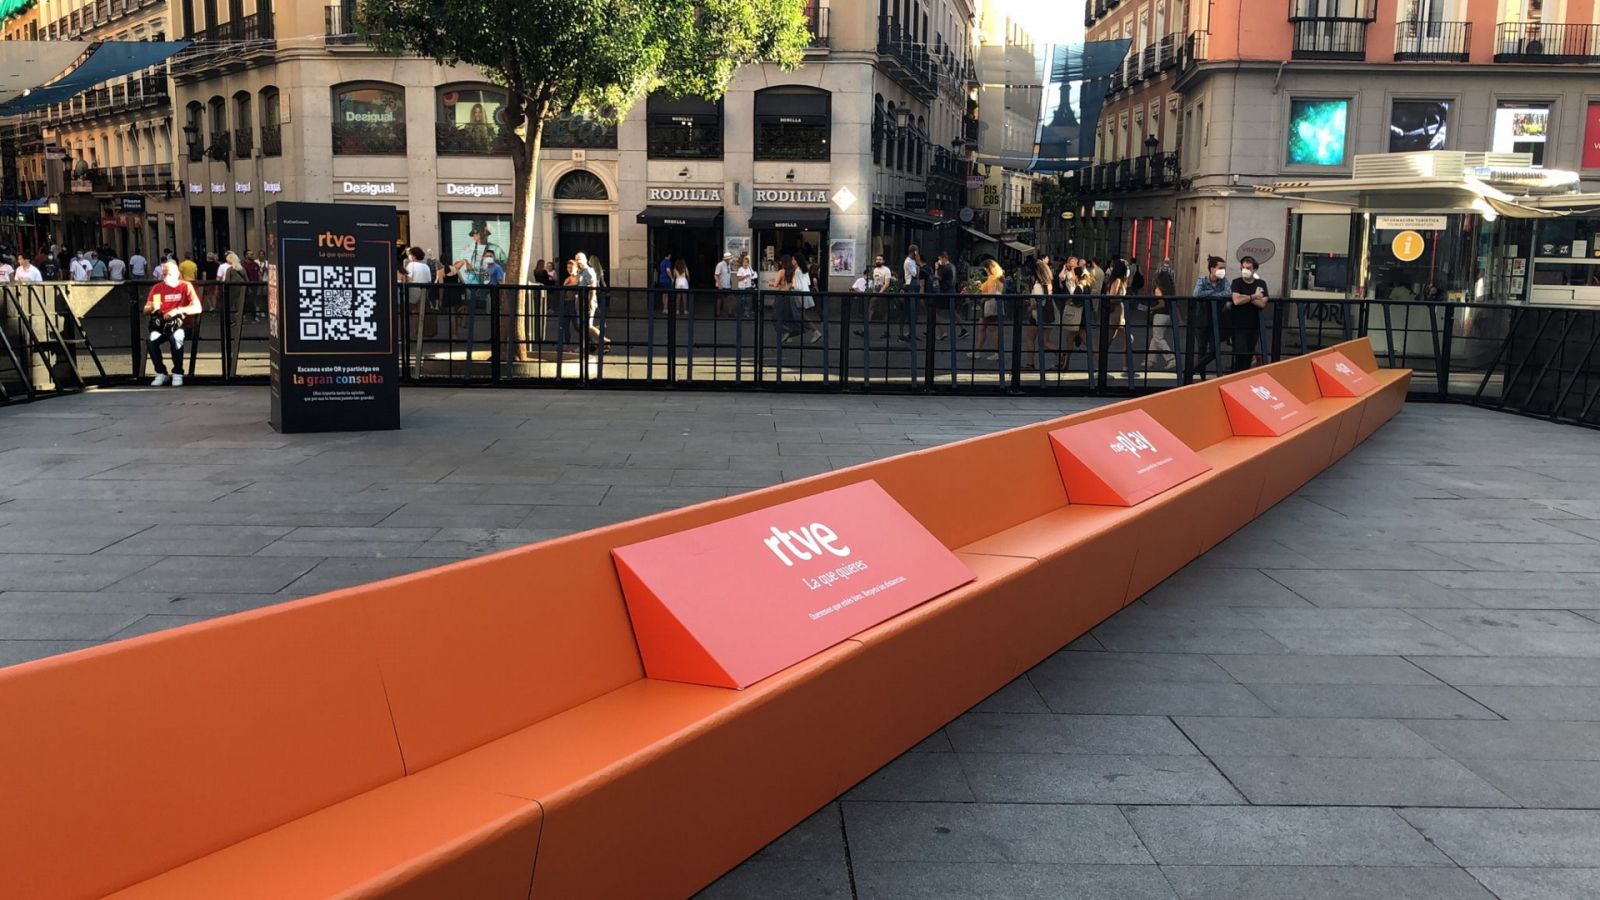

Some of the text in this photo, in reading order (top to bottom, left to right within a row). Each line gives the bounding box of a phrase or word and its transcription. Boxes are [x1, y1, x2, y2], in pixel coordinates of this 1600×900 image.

[649, 188, 721, 201] RODILLA
[755, 190, 828, 203] RODILLA
[984, 185, 997, 195] DIS
[983, 195, 999, 205] COS
[1021, 206, 1041, 214] DISCOS
[318, 232, 356, 251] rtve
[346, 366, 371, 374] participa
[293, 374, 384, 387] la gran consulta
[1115, 430, 1158, 459] play
[763, 522, 851, 566] rtve
[802, 560, 868, 590] La que quieres
